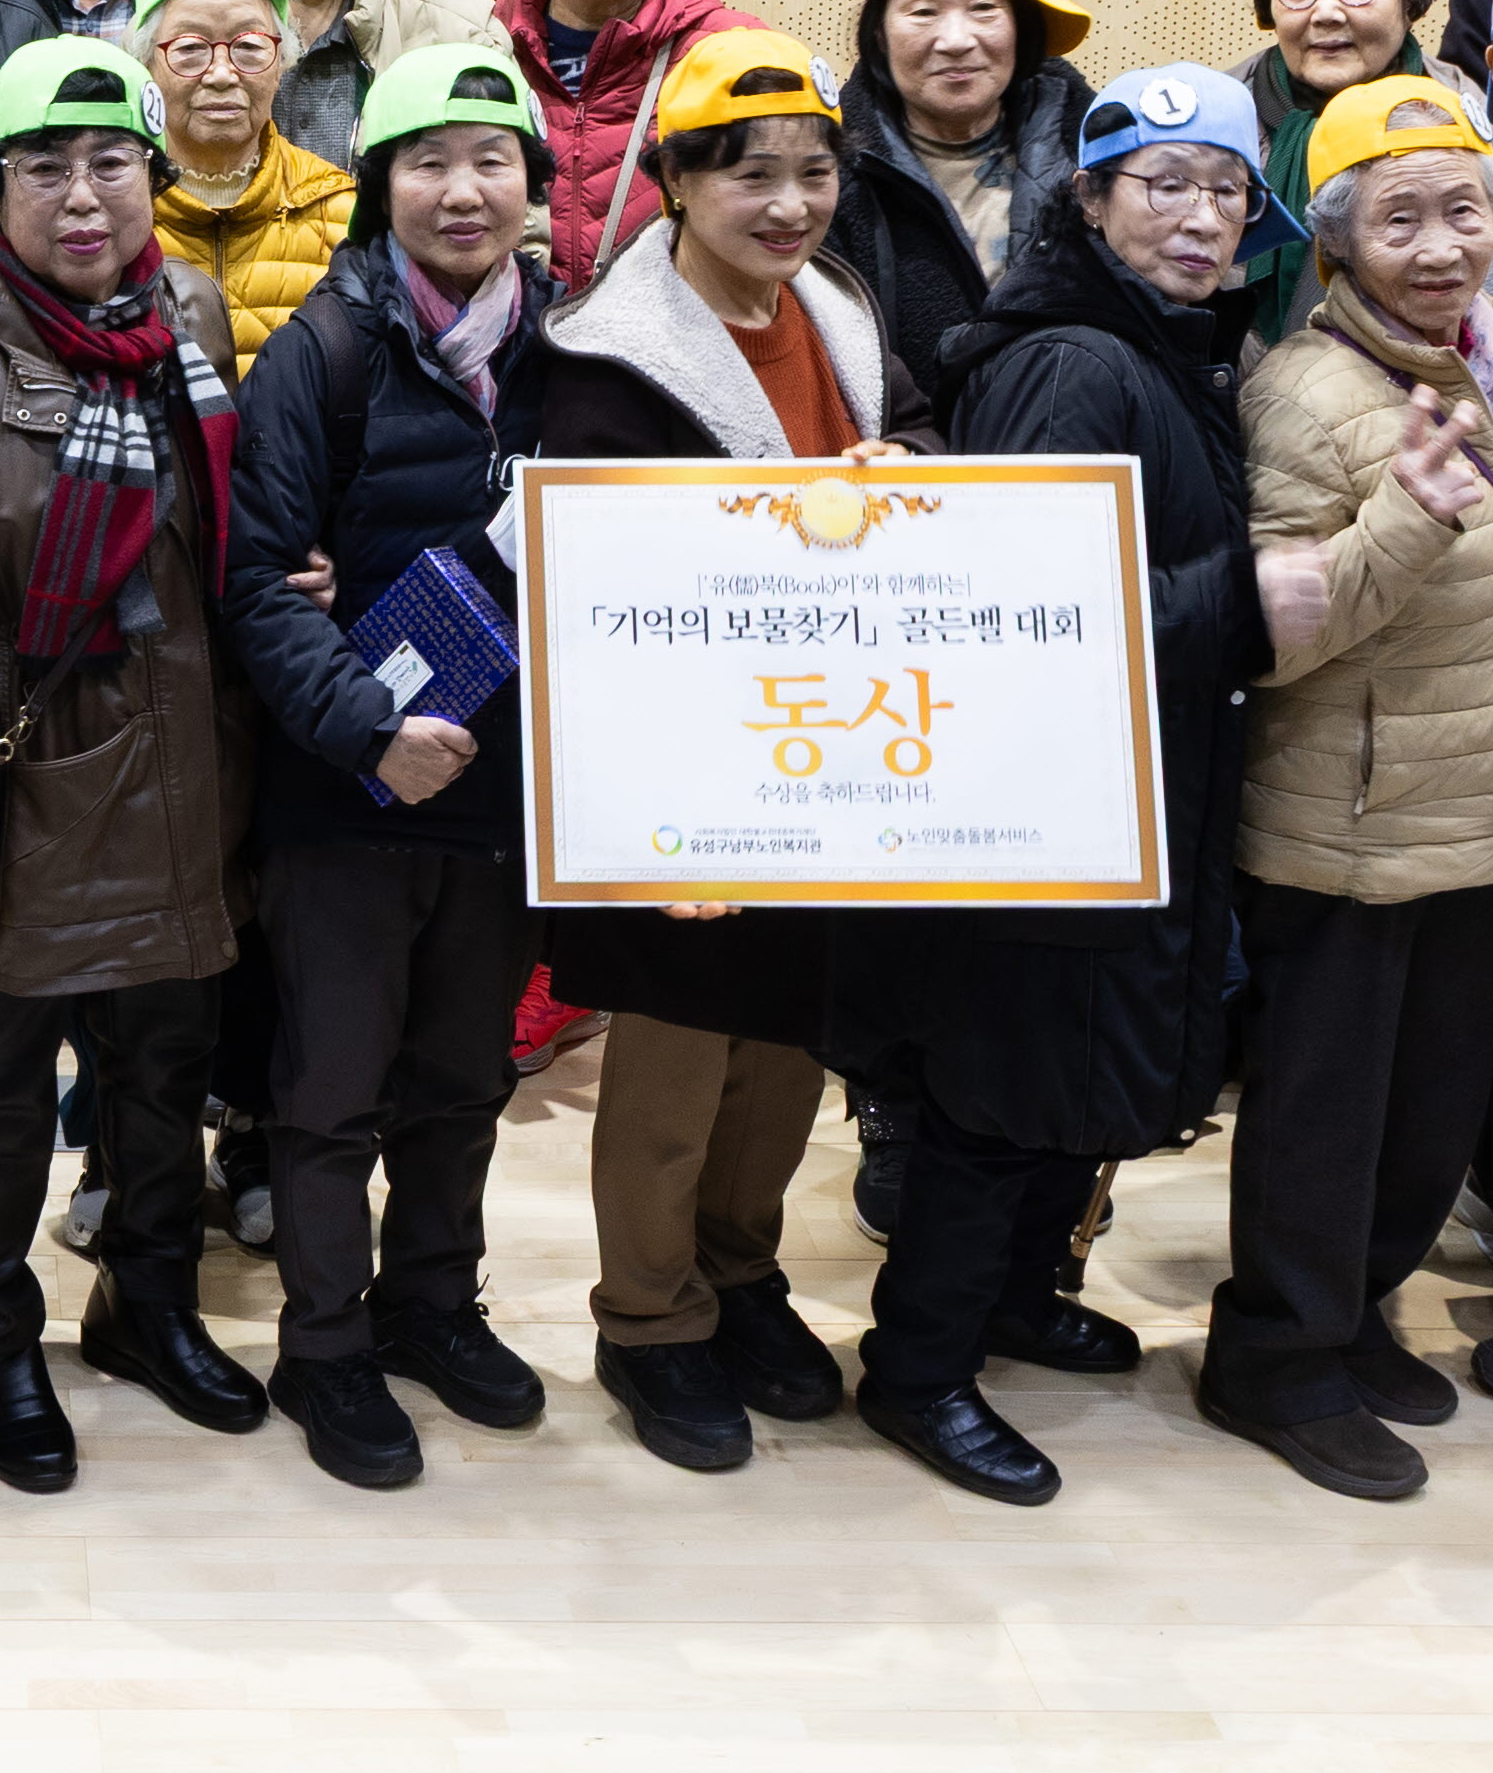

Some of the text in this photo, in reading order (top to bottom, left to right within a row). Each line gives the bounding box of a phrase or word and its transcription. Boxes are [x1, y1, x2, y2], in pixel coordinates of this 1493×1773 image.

[146, 89, 164, 128] 21
[1161, 88, 1181, 115] 1
[888, 573, 964, 596] 함께하는
[591, 604, 1084, 647] 「기억의 보물찾기」 골든벨 대회
[742, 667, 954, 777] 동상
[755, 781, 812, 805] 수상을
